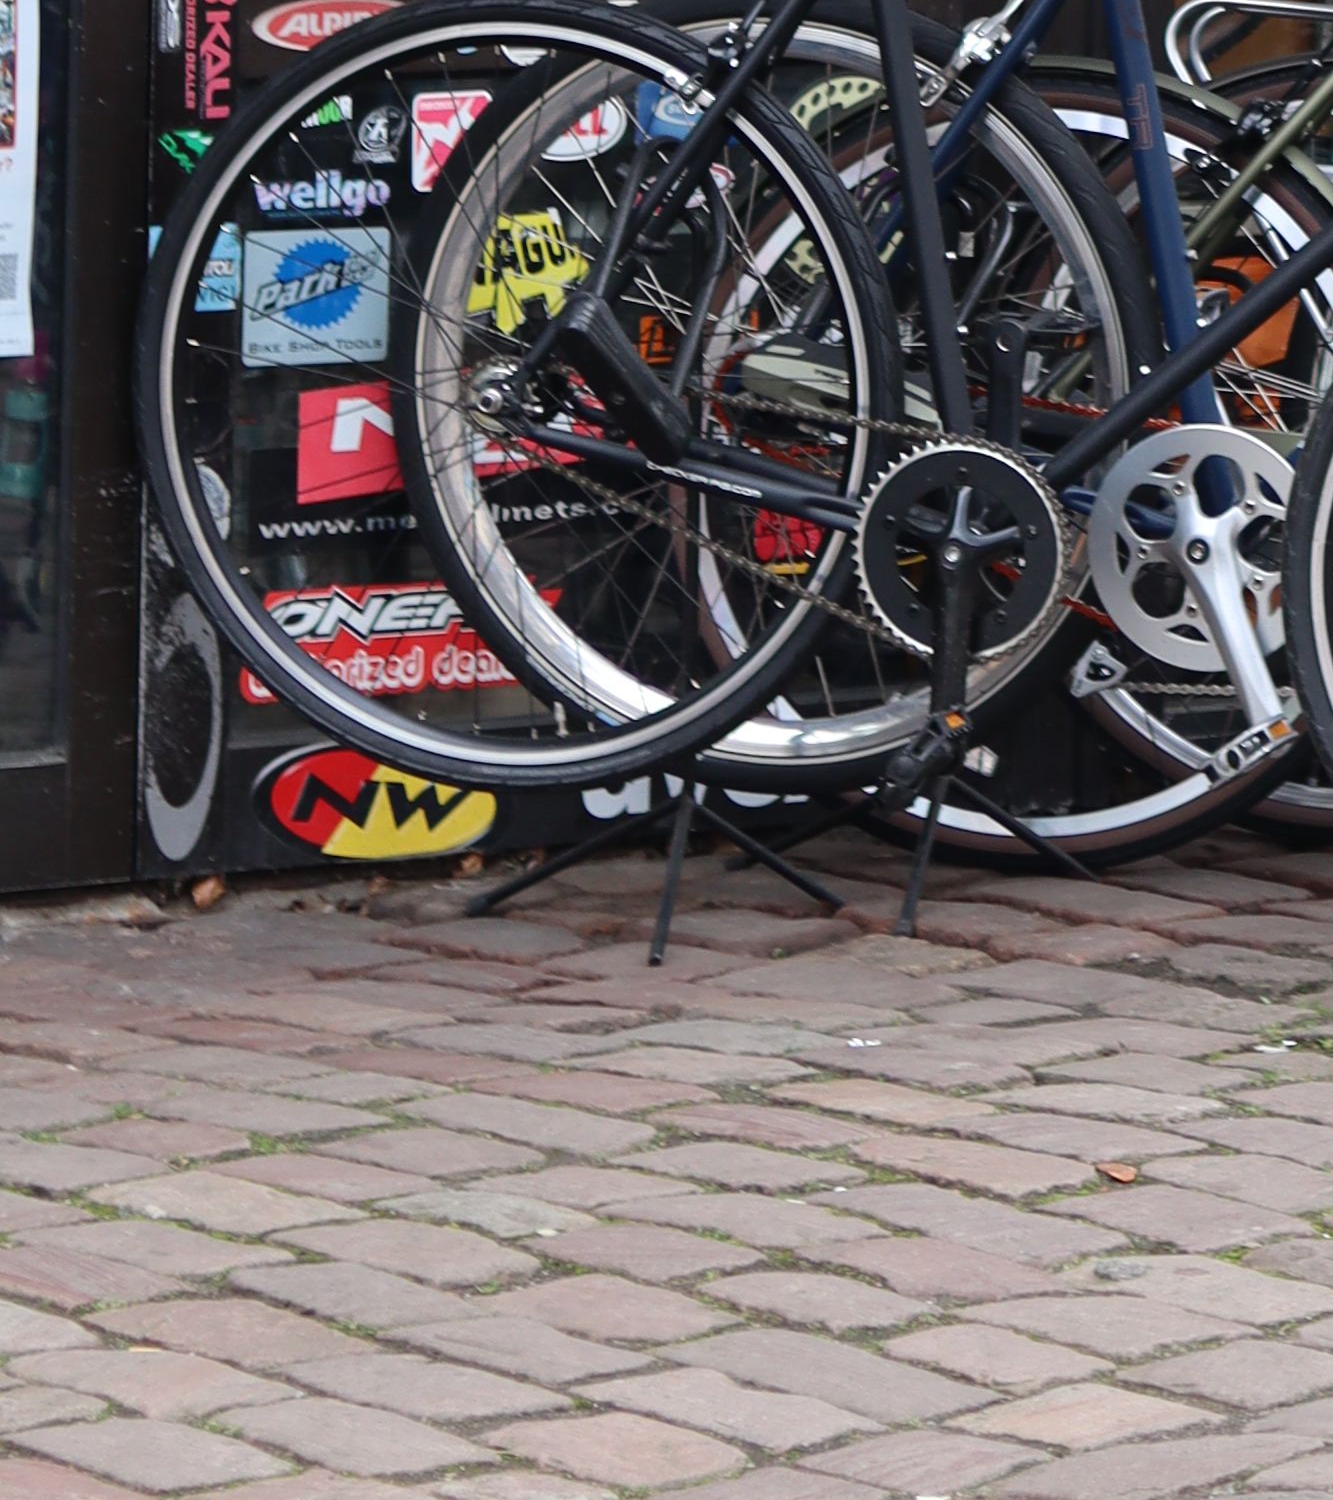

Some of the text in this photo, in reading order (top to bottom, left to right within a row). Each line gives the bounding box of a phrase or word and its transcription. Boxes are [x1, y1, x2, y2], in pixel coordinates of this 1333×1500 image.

[184, 51, 197, 110] DEALER
[201, 10, 232, 120] KALI
[254, 169, 391, 217] wellgo
[249, 343, 281, 355] BIKE
[336, 339, 383, 351] TOOLS
